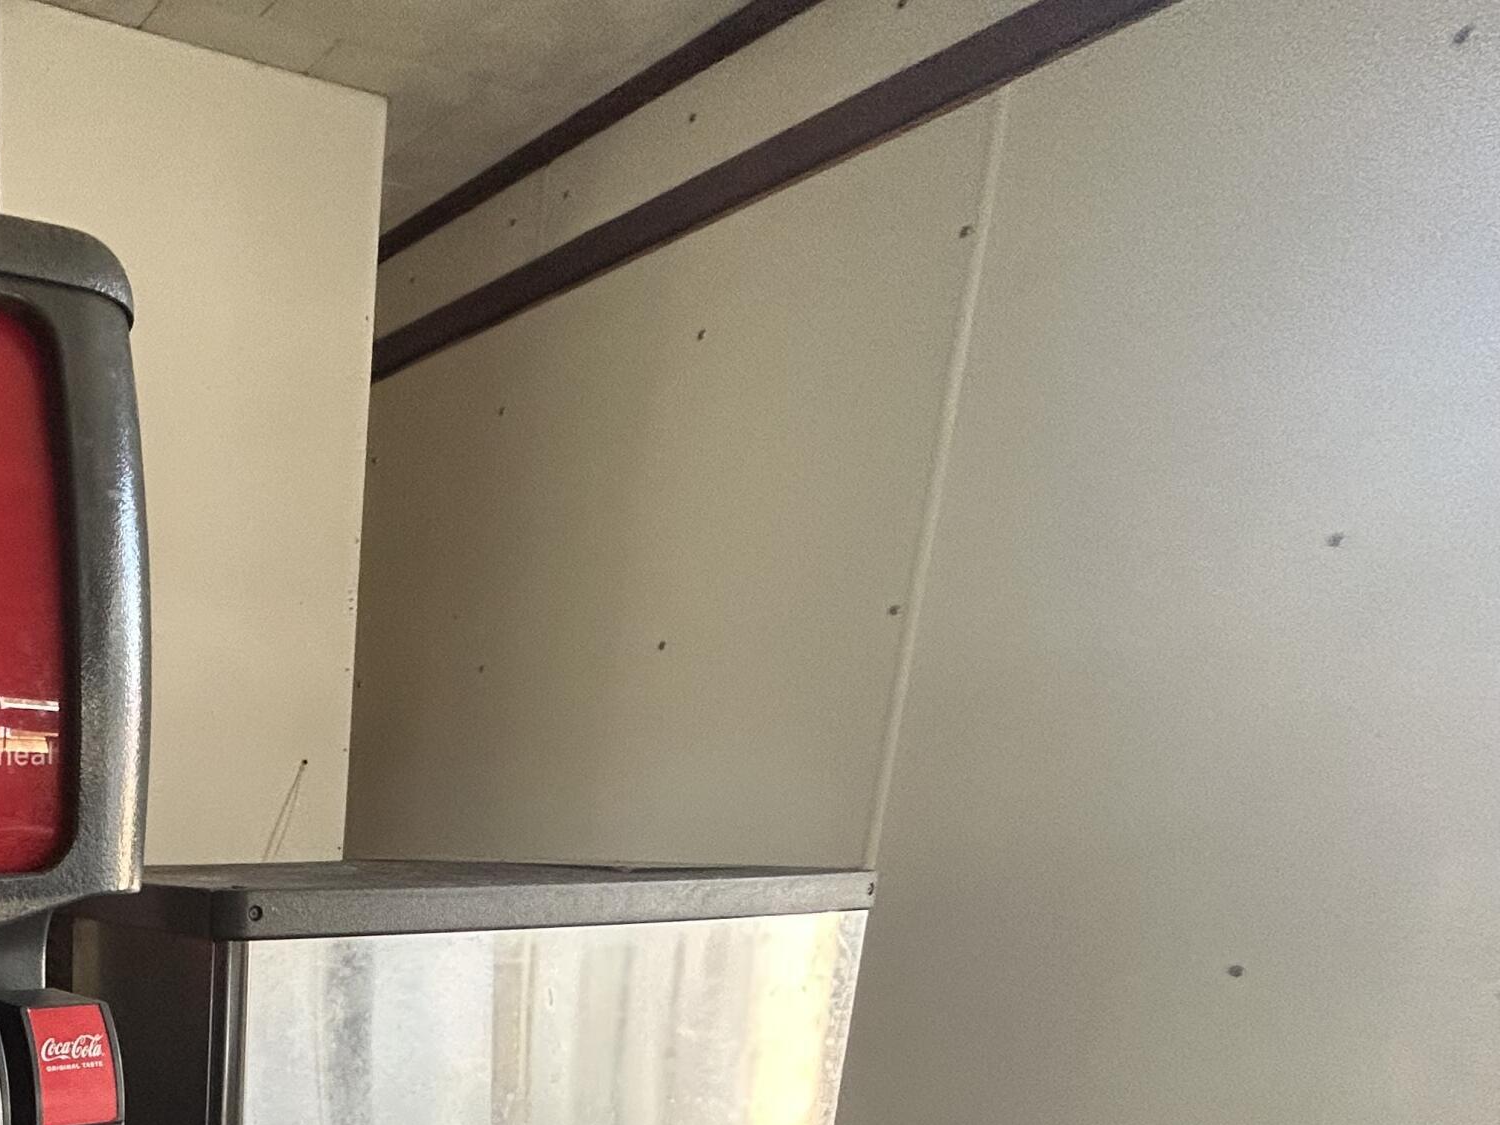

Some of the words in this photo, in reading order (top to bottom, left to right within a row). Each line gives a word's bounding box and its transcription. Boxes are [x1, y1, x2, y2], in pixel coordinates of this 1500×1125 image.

[41, 1033, 104, 1062] Coca-Cola
[46, 1063, 81, 1073] ORIGINAL
[82, 1060, 104, 1069] TASTE
